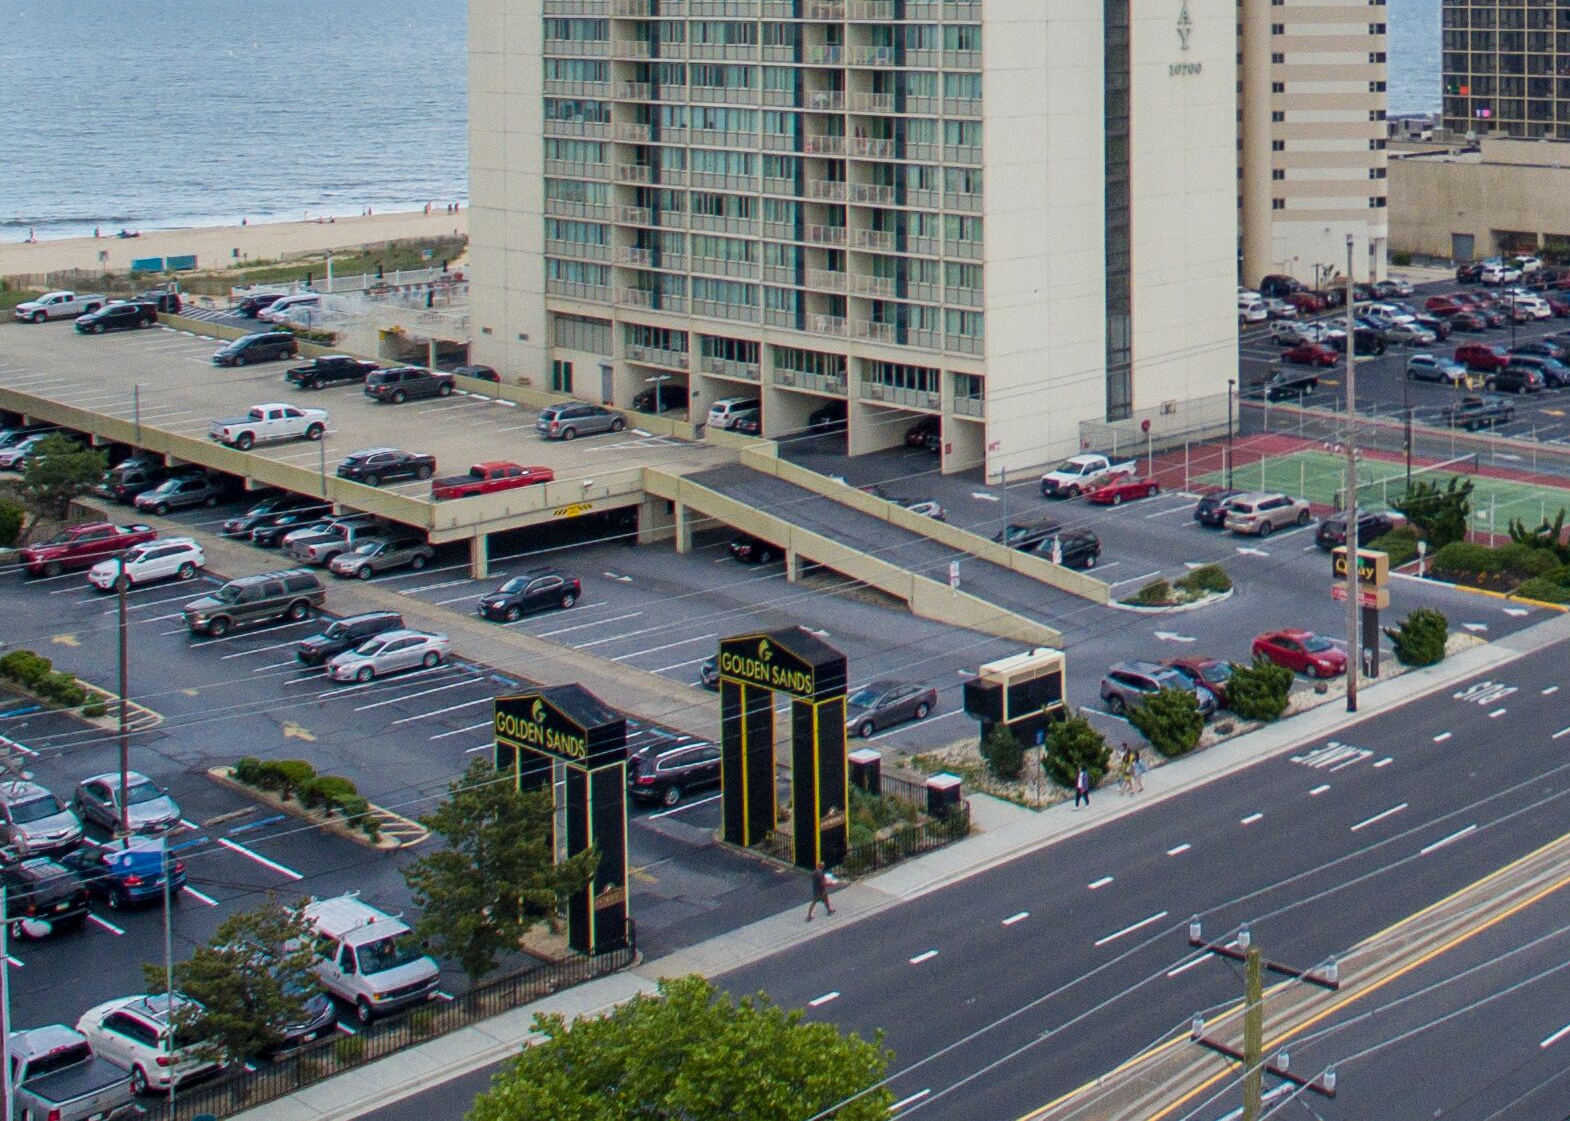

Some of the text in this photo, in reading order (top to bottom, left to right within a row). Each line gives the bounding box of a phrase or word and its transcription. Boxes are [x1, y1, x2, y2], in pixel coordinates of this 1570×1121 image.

[1336, 558, 1375, 580] Qay
[722, 652, 814, 694] GOLDEN SANDS
[496, 711, 587, 759] GOLDEN SANDS
